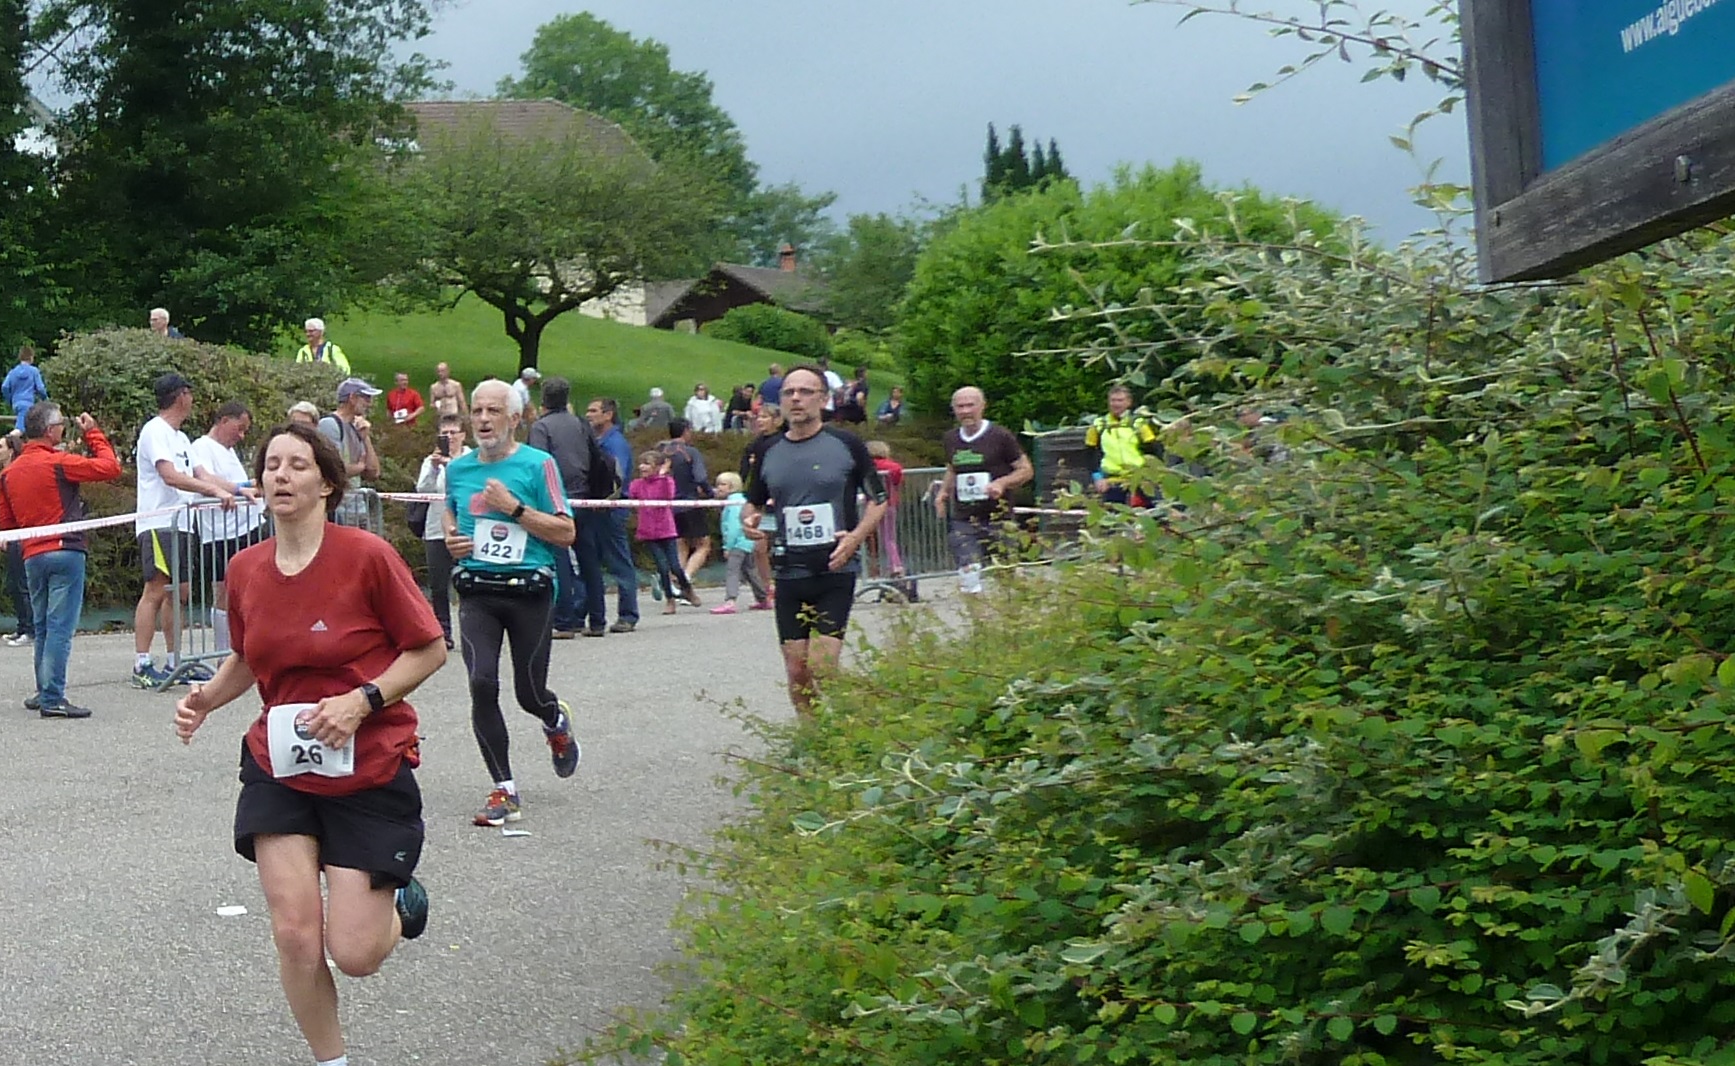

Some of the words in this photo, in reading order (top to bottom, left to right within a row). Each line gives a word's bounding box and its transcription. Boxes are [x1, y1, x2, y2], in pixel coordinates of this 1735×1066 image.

[1621, 0, 1718, 53] www.aigue
[787, 525, 824, 540] 1468
[480, 542, 512, 559] 422
[291, 744, 323, 766] 26
